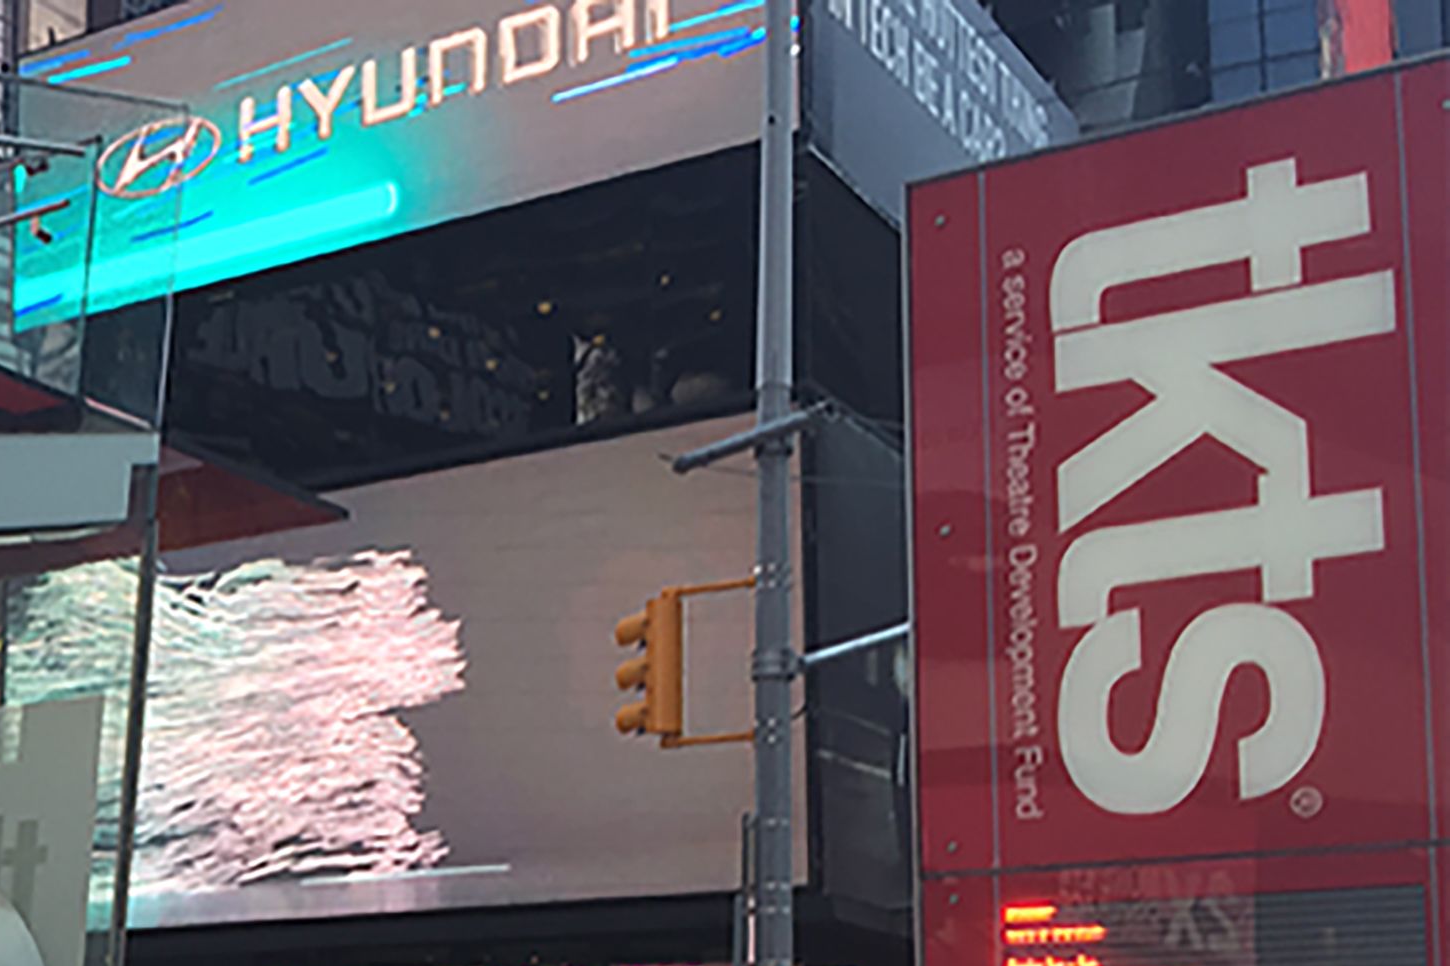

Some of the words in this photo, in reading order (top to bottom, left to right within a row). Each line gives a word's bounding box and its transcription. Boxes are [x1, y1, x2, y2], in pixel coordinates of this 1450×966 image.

[238, 0, 670, 164] HYUNDAI
[1001, 248, 1026, 269] a
[1001, 274, 1033, 381] service
[1004, 386, 1035, 417] of
[1006, 421, 1036, 537] Theatre
[1050, 157, 1397, 816] tkts
[1005, 543, 1039, 739] Development
[1014, 745, 1044, 820] Fund
